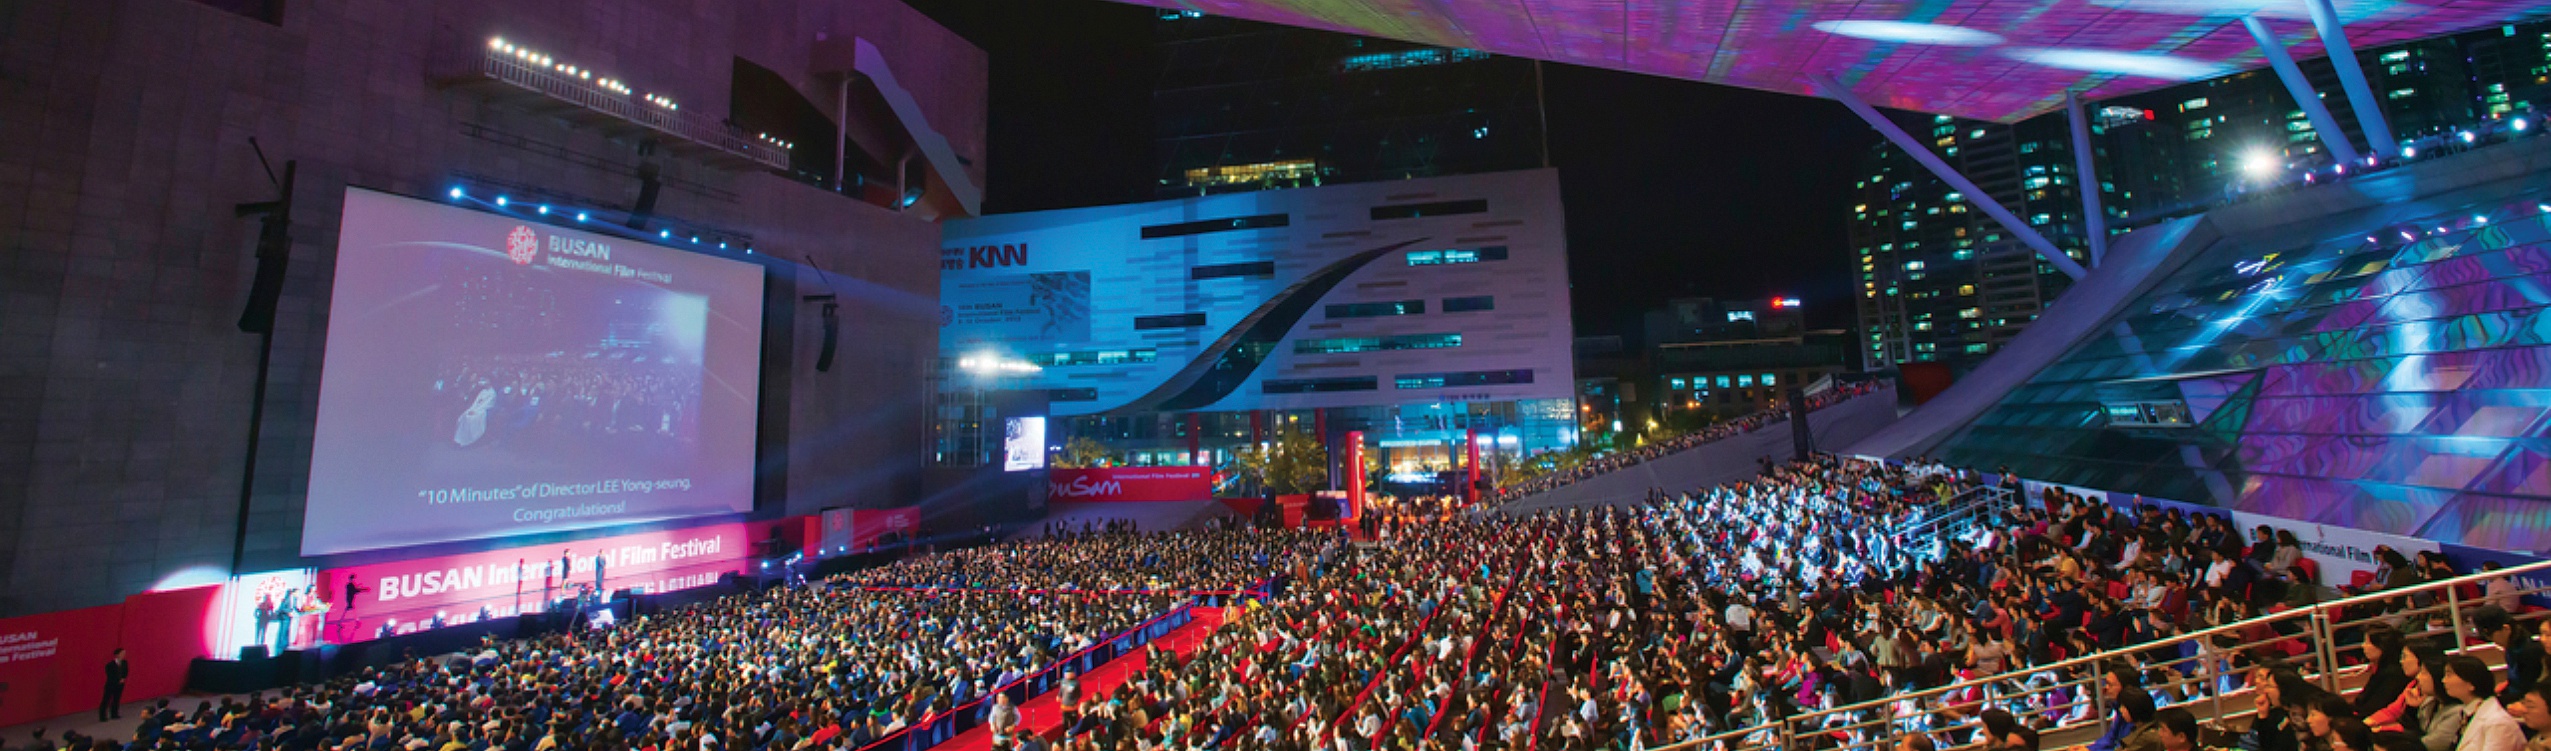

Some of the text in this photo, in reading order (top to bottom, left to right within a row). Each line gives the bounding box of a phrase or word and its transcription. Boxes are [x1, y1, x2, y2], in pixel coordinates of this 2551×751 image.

[549, 235, 611, 260] BUSAN
[969, 243, 1027, 268] KNN
[547, 253, 613, 275] International
[615, 264, 636, 278] Film
[520, 482, 539, 499] of
[540, 481, 597, 498] Director
[597, 478, 619, 494] LEE
[513, 499, 626, 523] Congratulations!
[378, 565, 484, 601] BUSAN
[619, 544, 656, 567] Film
[660, 534, 720, 561] Festival
[2347, 546, 2372, 564] Film
